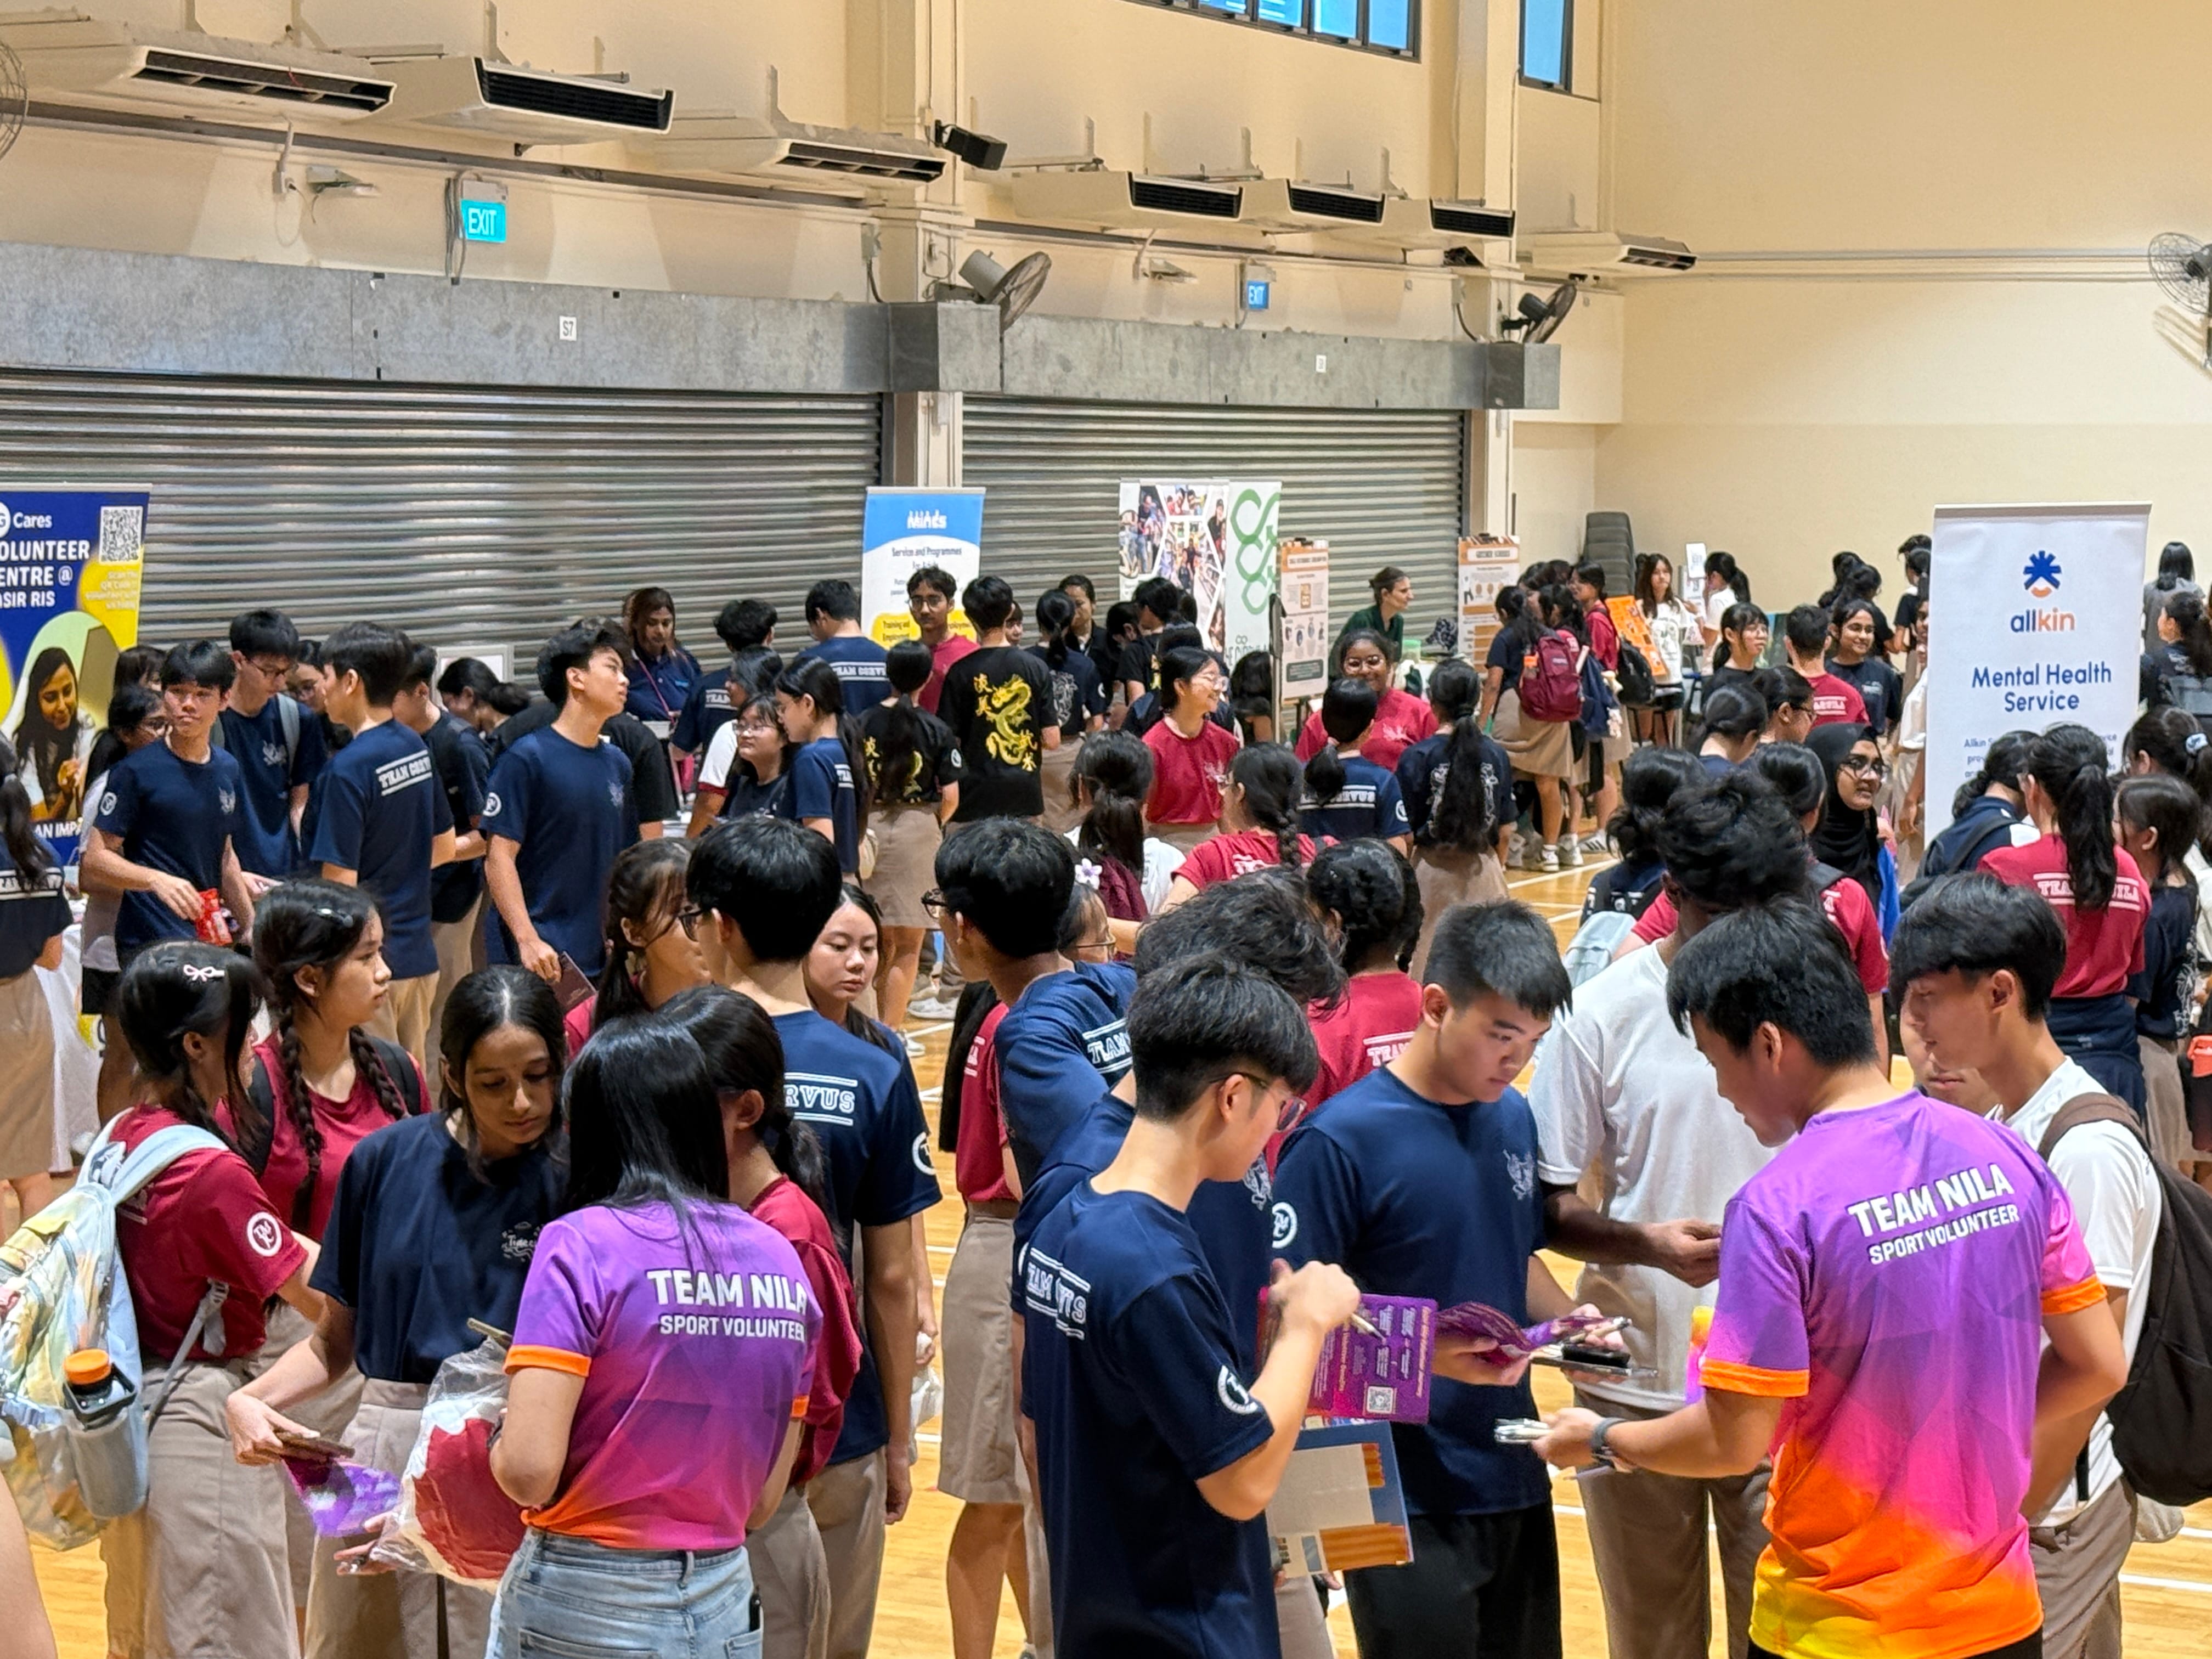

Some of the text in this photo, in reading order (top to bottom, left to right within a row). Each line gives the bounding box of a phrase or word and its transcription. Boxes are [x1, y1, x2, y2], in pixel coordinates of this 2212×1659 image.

[469, 207, 497, 236] EXIT
[563, 320, 574, 337] S7
[13, 512, 53, 529] Cares
[0, 540, 90, 561] OLUNTEER
[0, 565, 74, 587] ENTRE @
[30, 591, 55, 608] RIS
[2010, 607, 2075, 633] allkin
[1971, 661, 2112, 689] Mental Health
[2004, 690, 2080, 713] Service
[2037, 880, 2074, 897] TEA
[783, 1084, 856, 1114] RVUS
[1847, 1163, 2015, 1238] TEAM NILA
[1869, 1204, 2020, 1265] SPORT VOLUNTEER
[646, 1269, 808, 1316] TEAM NILA
[659, 1314, 720, 1335] SPORT
